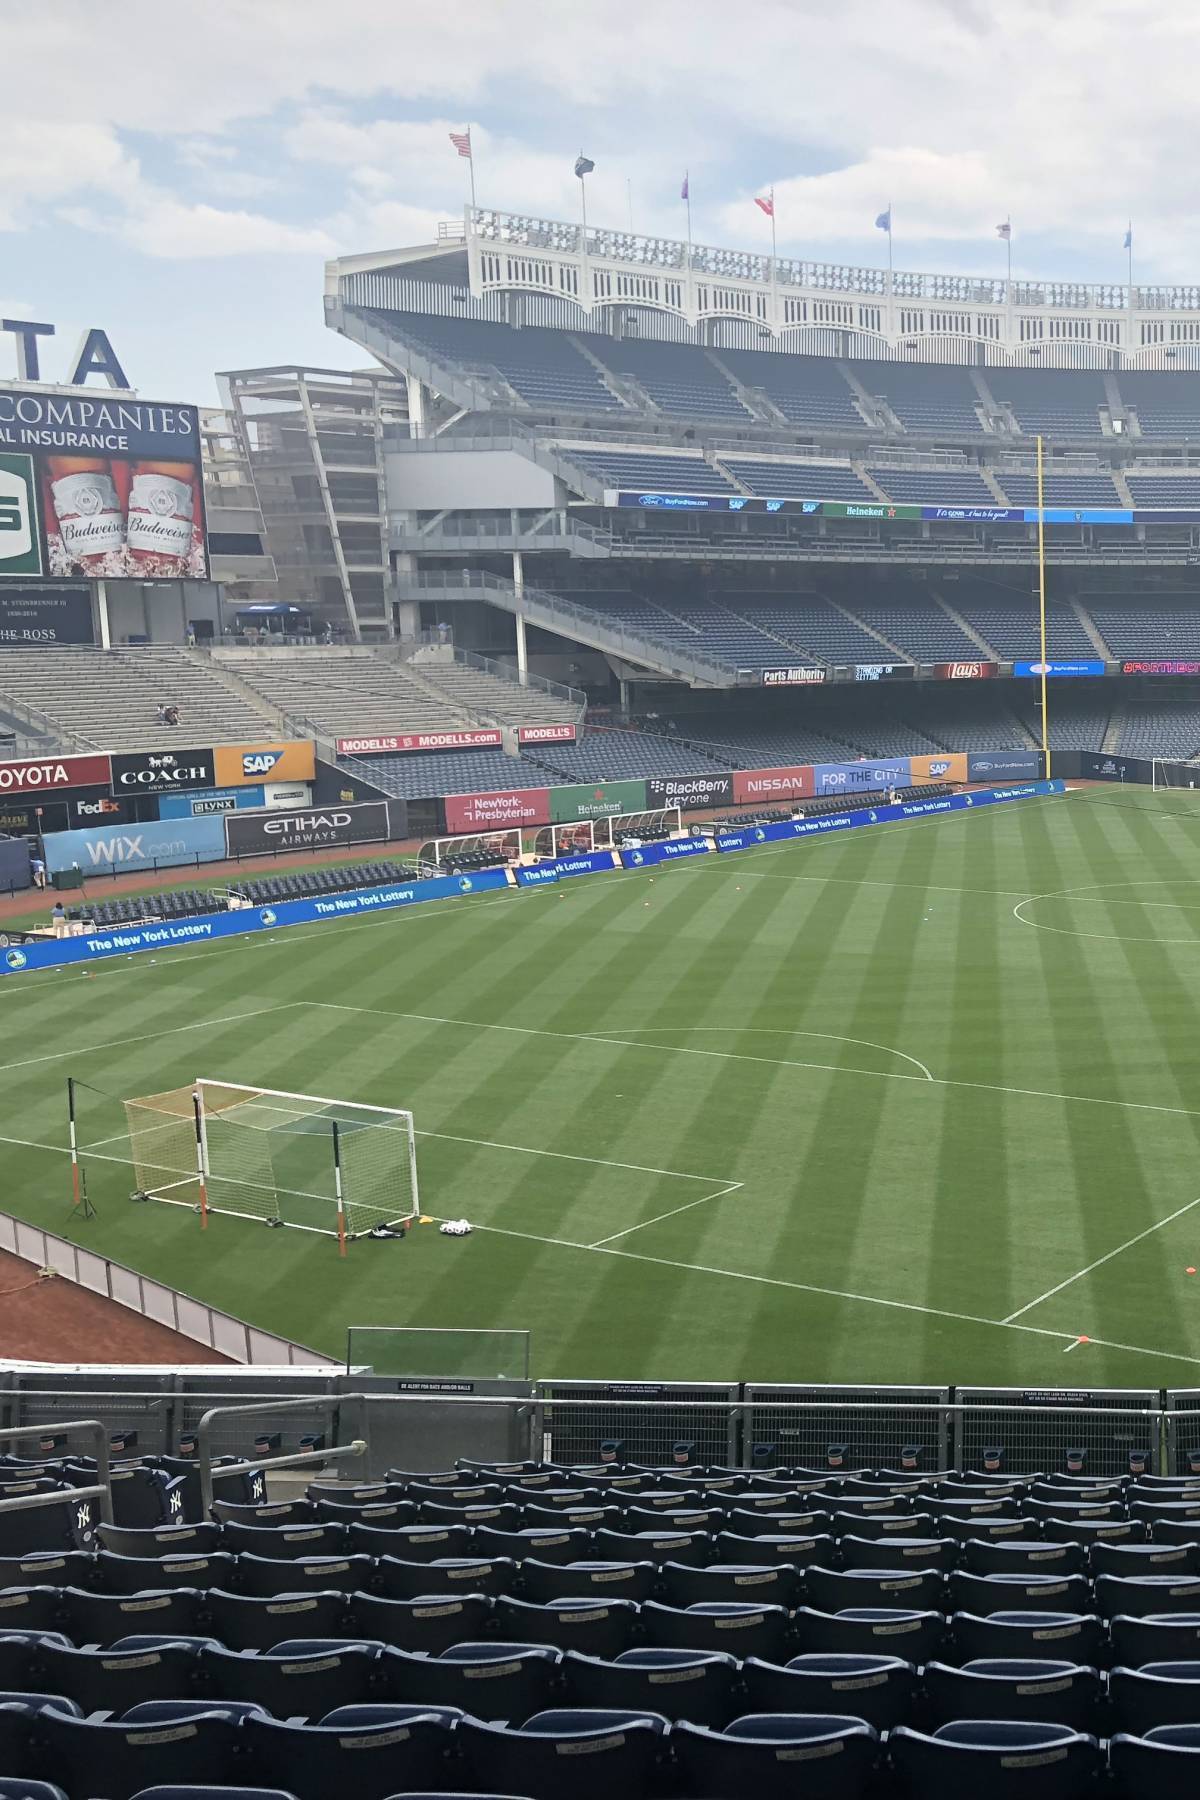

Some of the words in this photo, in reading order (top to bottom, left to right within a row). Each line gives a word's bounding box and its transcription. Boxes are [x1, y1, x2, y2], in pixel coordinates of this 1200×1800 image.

[0, 395, 192, 435] COMPANIES
[21, 429, 129, 450] INSURANCE
[729, 501, 744, 510] SAP
[766, 502, 780, 511] SAP
[802, 504, 816, 512] SAP
[847, 507, 884, 517] Heineken
[23, 629, 56, 640] BOSS
[764, 671, 787, 682] Parts
[787, 669, 826, 681] Authority
[855, 666, 883, 674] STANDING
[855, 673, 880, 681] SITTING
[524, 727, 570, 740] MODELL'S
[342, 738, 397, 751] MODELL'S
[418, 733, 497, 747] MODELLS.com
[243, 754, 276, 774] SAP
[929, 763, 953, 776] SAP
[0, 764, 69, 786] OYOTA
[120, 766, 207, 785] COACH
[822, 772, 846, 786] FOR
[849, 770, 872, 784] THE
[664, 780, 728, 796] BlackBerry
[747, 777, 803, 792] NISSAN
[77, 799, 120, 815] FedEx
[204, 801, 233, 811] LYNX
[474, 797, 523, 810] NewYork-
[578, 802, 622, 815] Heineken
[914, 805, 923, 813] New
[923, 803, 935, 812] York
[935, 801, 951, 811] Lottery
[475, 807, 536, 821] Presbyterian
[263, 812, 352, 834] ETIHAD
[794, 825, 805, 833] The
[805, 823, 818, 831] New
[818, 821, 831, 829] York
[831, 818, 850, 828] Lottery
[281, 831, 337, 845] AIRWAYS
[664, 845, 677, 854] The
[678, 842, 693, 852] New
[719, 836, 743, 848] Lottery
[524, 869, 540, 881] The
[564, 858, 592, 872] Lottery
[315, 901, 338, 913] The
[339, 898, 359, 911] New
[358, 894, 380, 909] York
[380, 888, 415, 906] Lottery
[87, 938, 114, 953] The
[115, 932, 142, 948] New
[141, 928, 168, 945] York
[170, 922, 212, 942] Lottery
[170, 1489, 182, 1514] NY
[77, 1504, 90, 1529] NY
